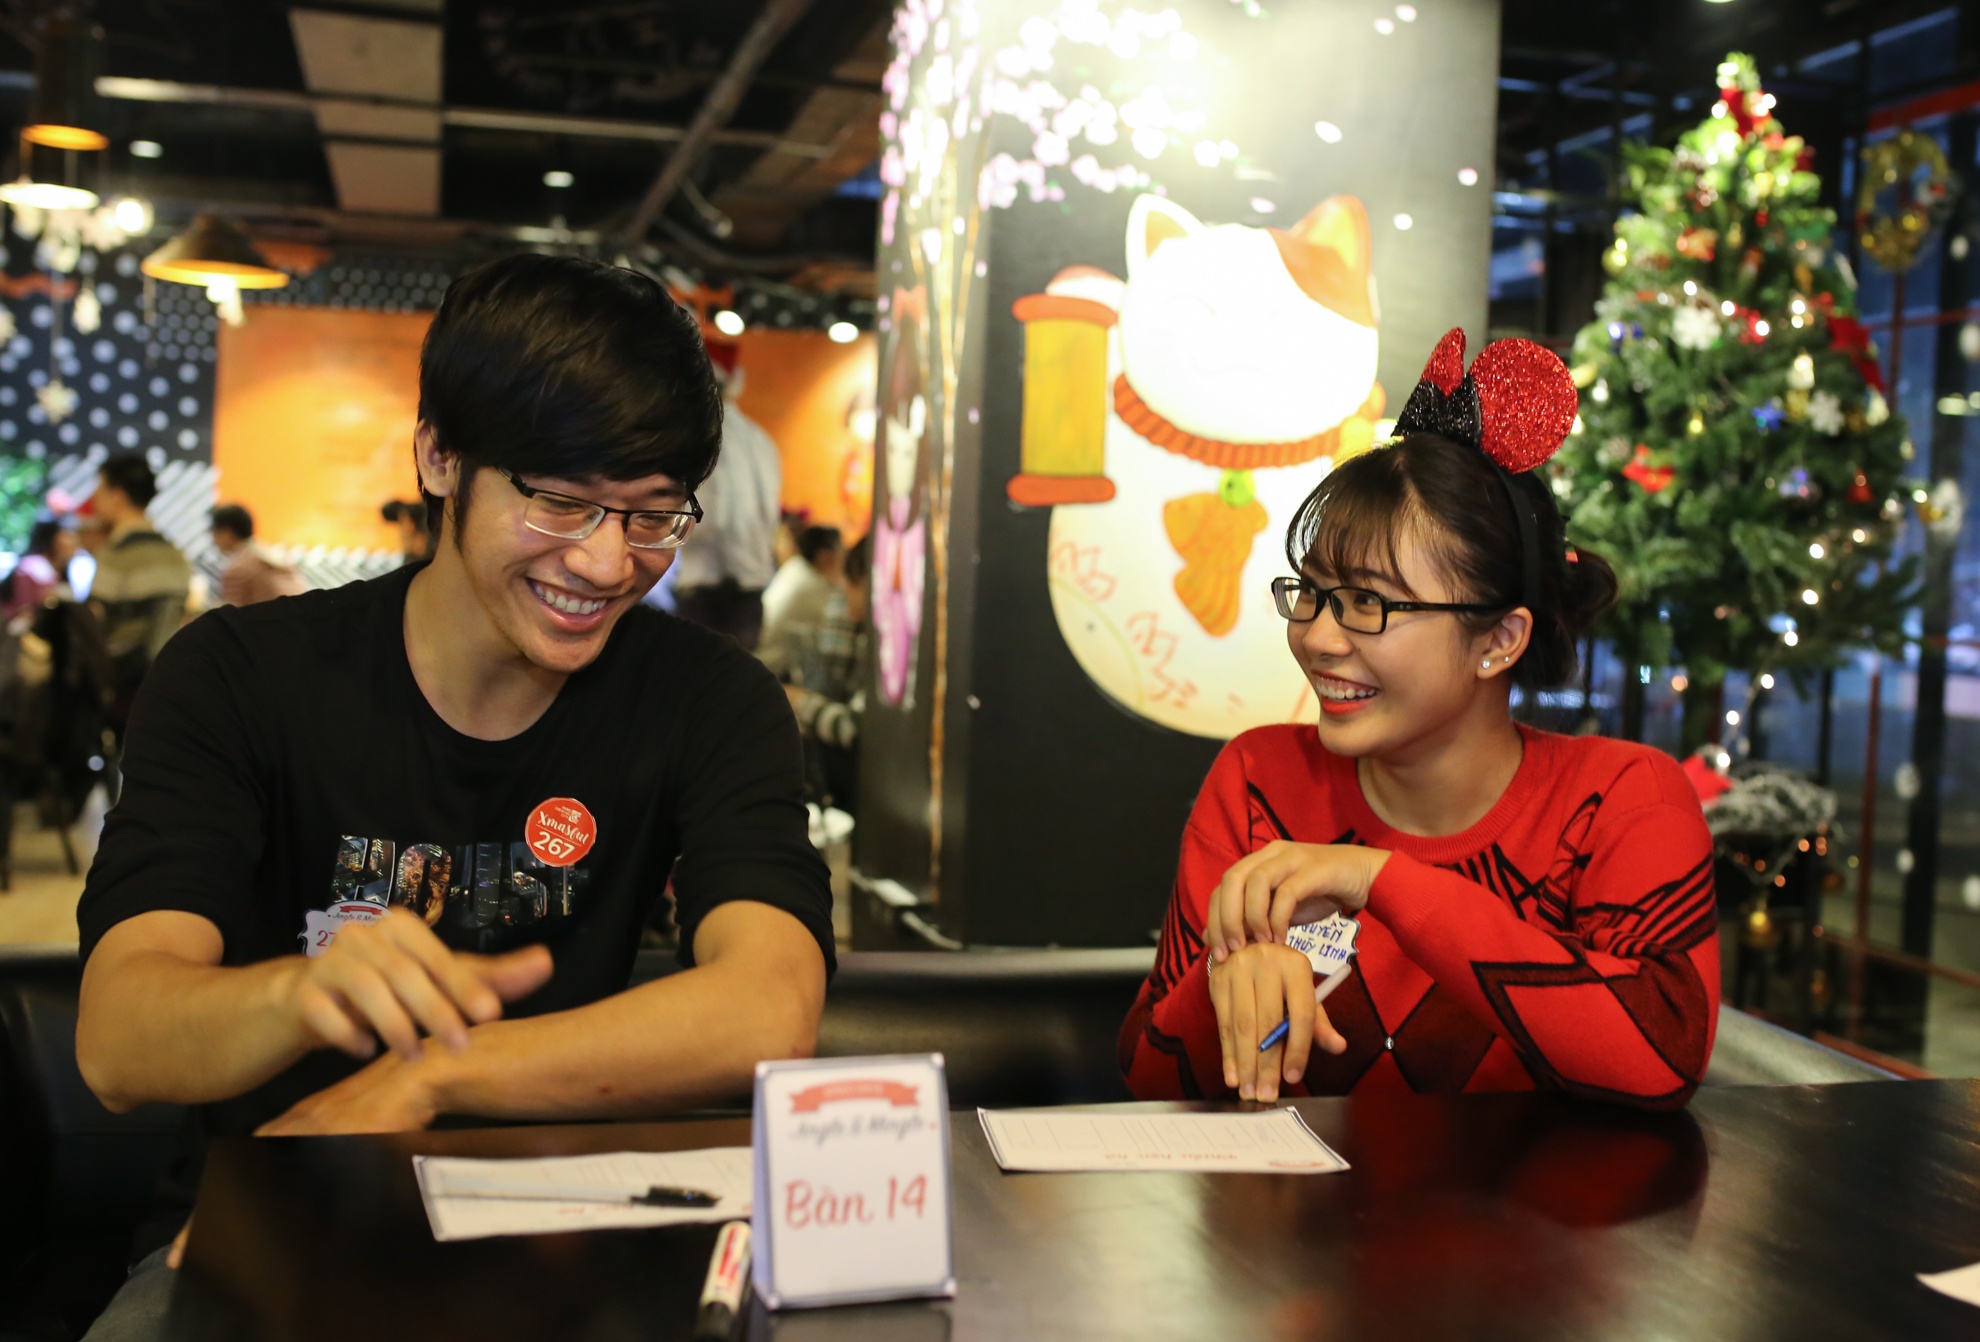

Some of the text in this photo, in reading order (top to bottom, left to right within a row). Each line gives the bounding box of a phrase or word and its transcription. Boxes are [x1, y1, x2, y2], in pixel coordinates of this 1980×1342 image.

[533, 831, 576, 859] 267
[1319, 943, 1347, 960] LINH
[784, 1172, 928, 1229] Bàn 14
